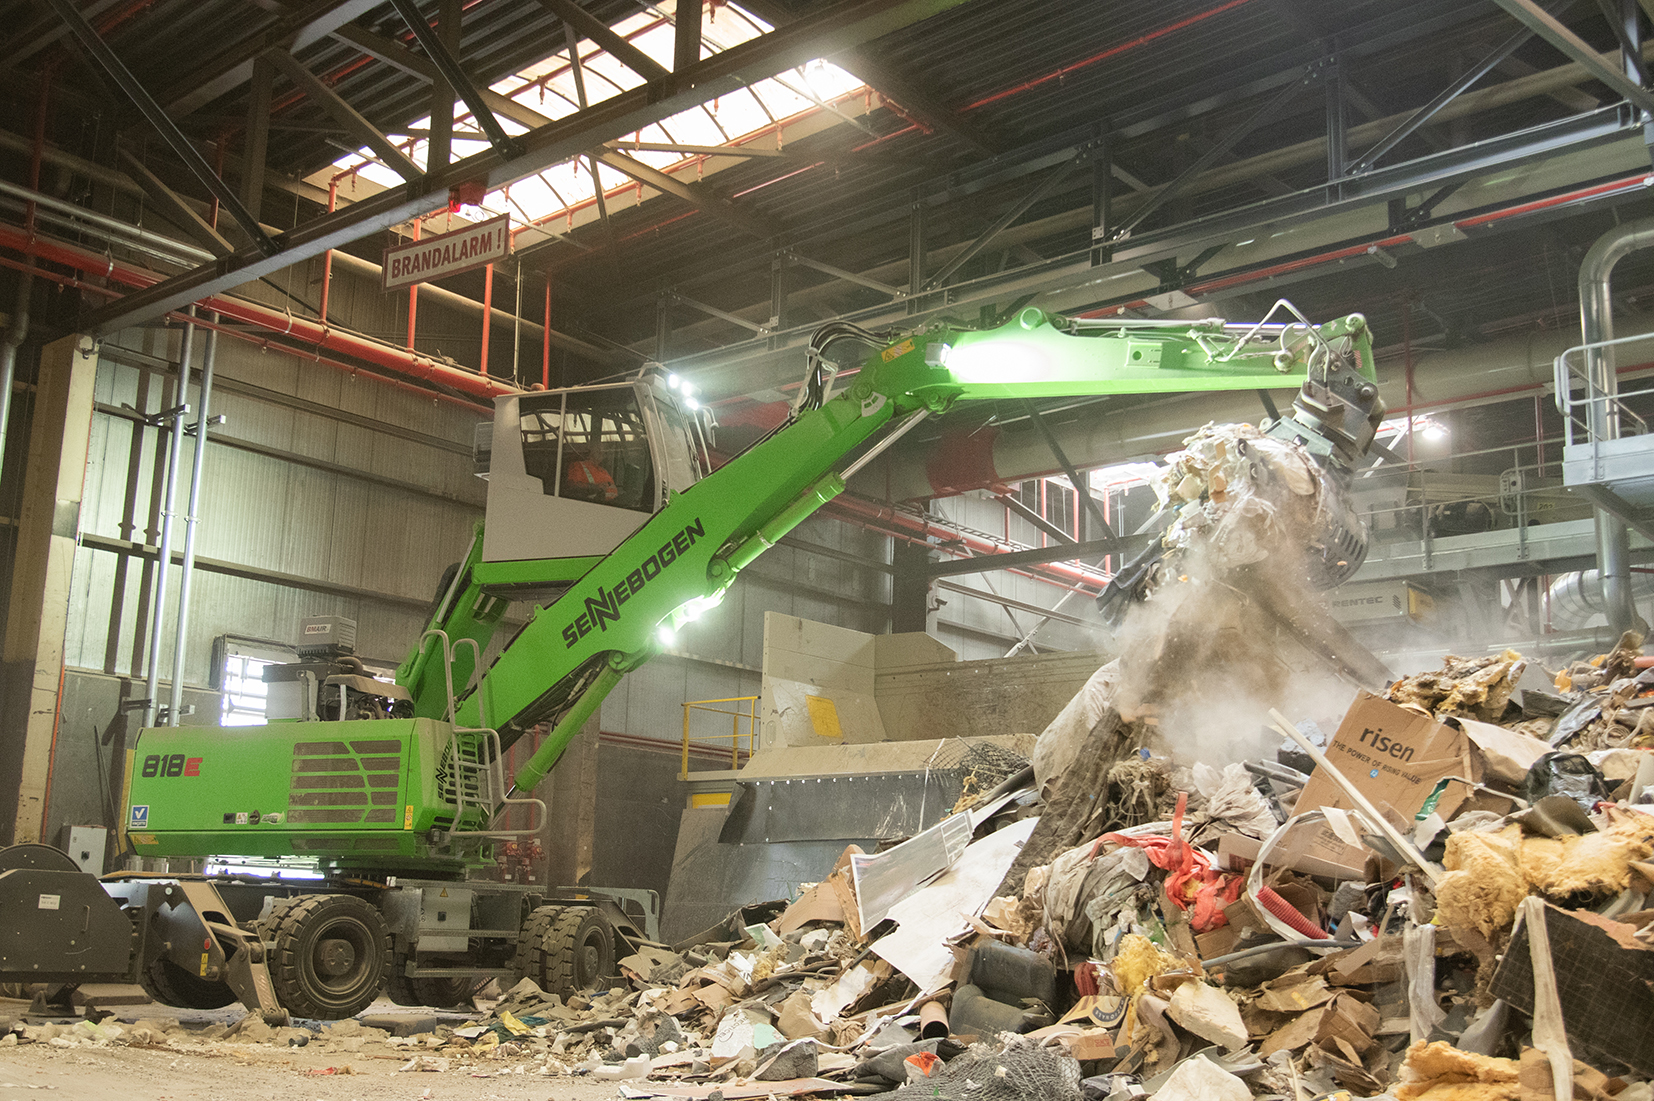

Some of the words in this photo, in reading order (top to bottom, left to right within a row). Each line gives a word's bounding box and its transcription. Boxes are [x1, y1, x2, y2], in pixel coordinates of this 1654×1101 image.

[391, 231, 493, 280] BRANDALARM
[496, 227, 502, 250] !
[561, 517, 706, 649] SENNEBOGEN
[141, 754, 203, 778] 818E
[435, 737, 454, 800] SENNEBOG
[1333, 740, 1346, 752] THE
[1347, 747, 1370, 764] POWER
[1372, 759, 1382, 768] OF
[1382, 763, 1401, 777] RISING
[1401, 770, 1422, 785] VALUE
[1359, 727, 1415, 762] risen
